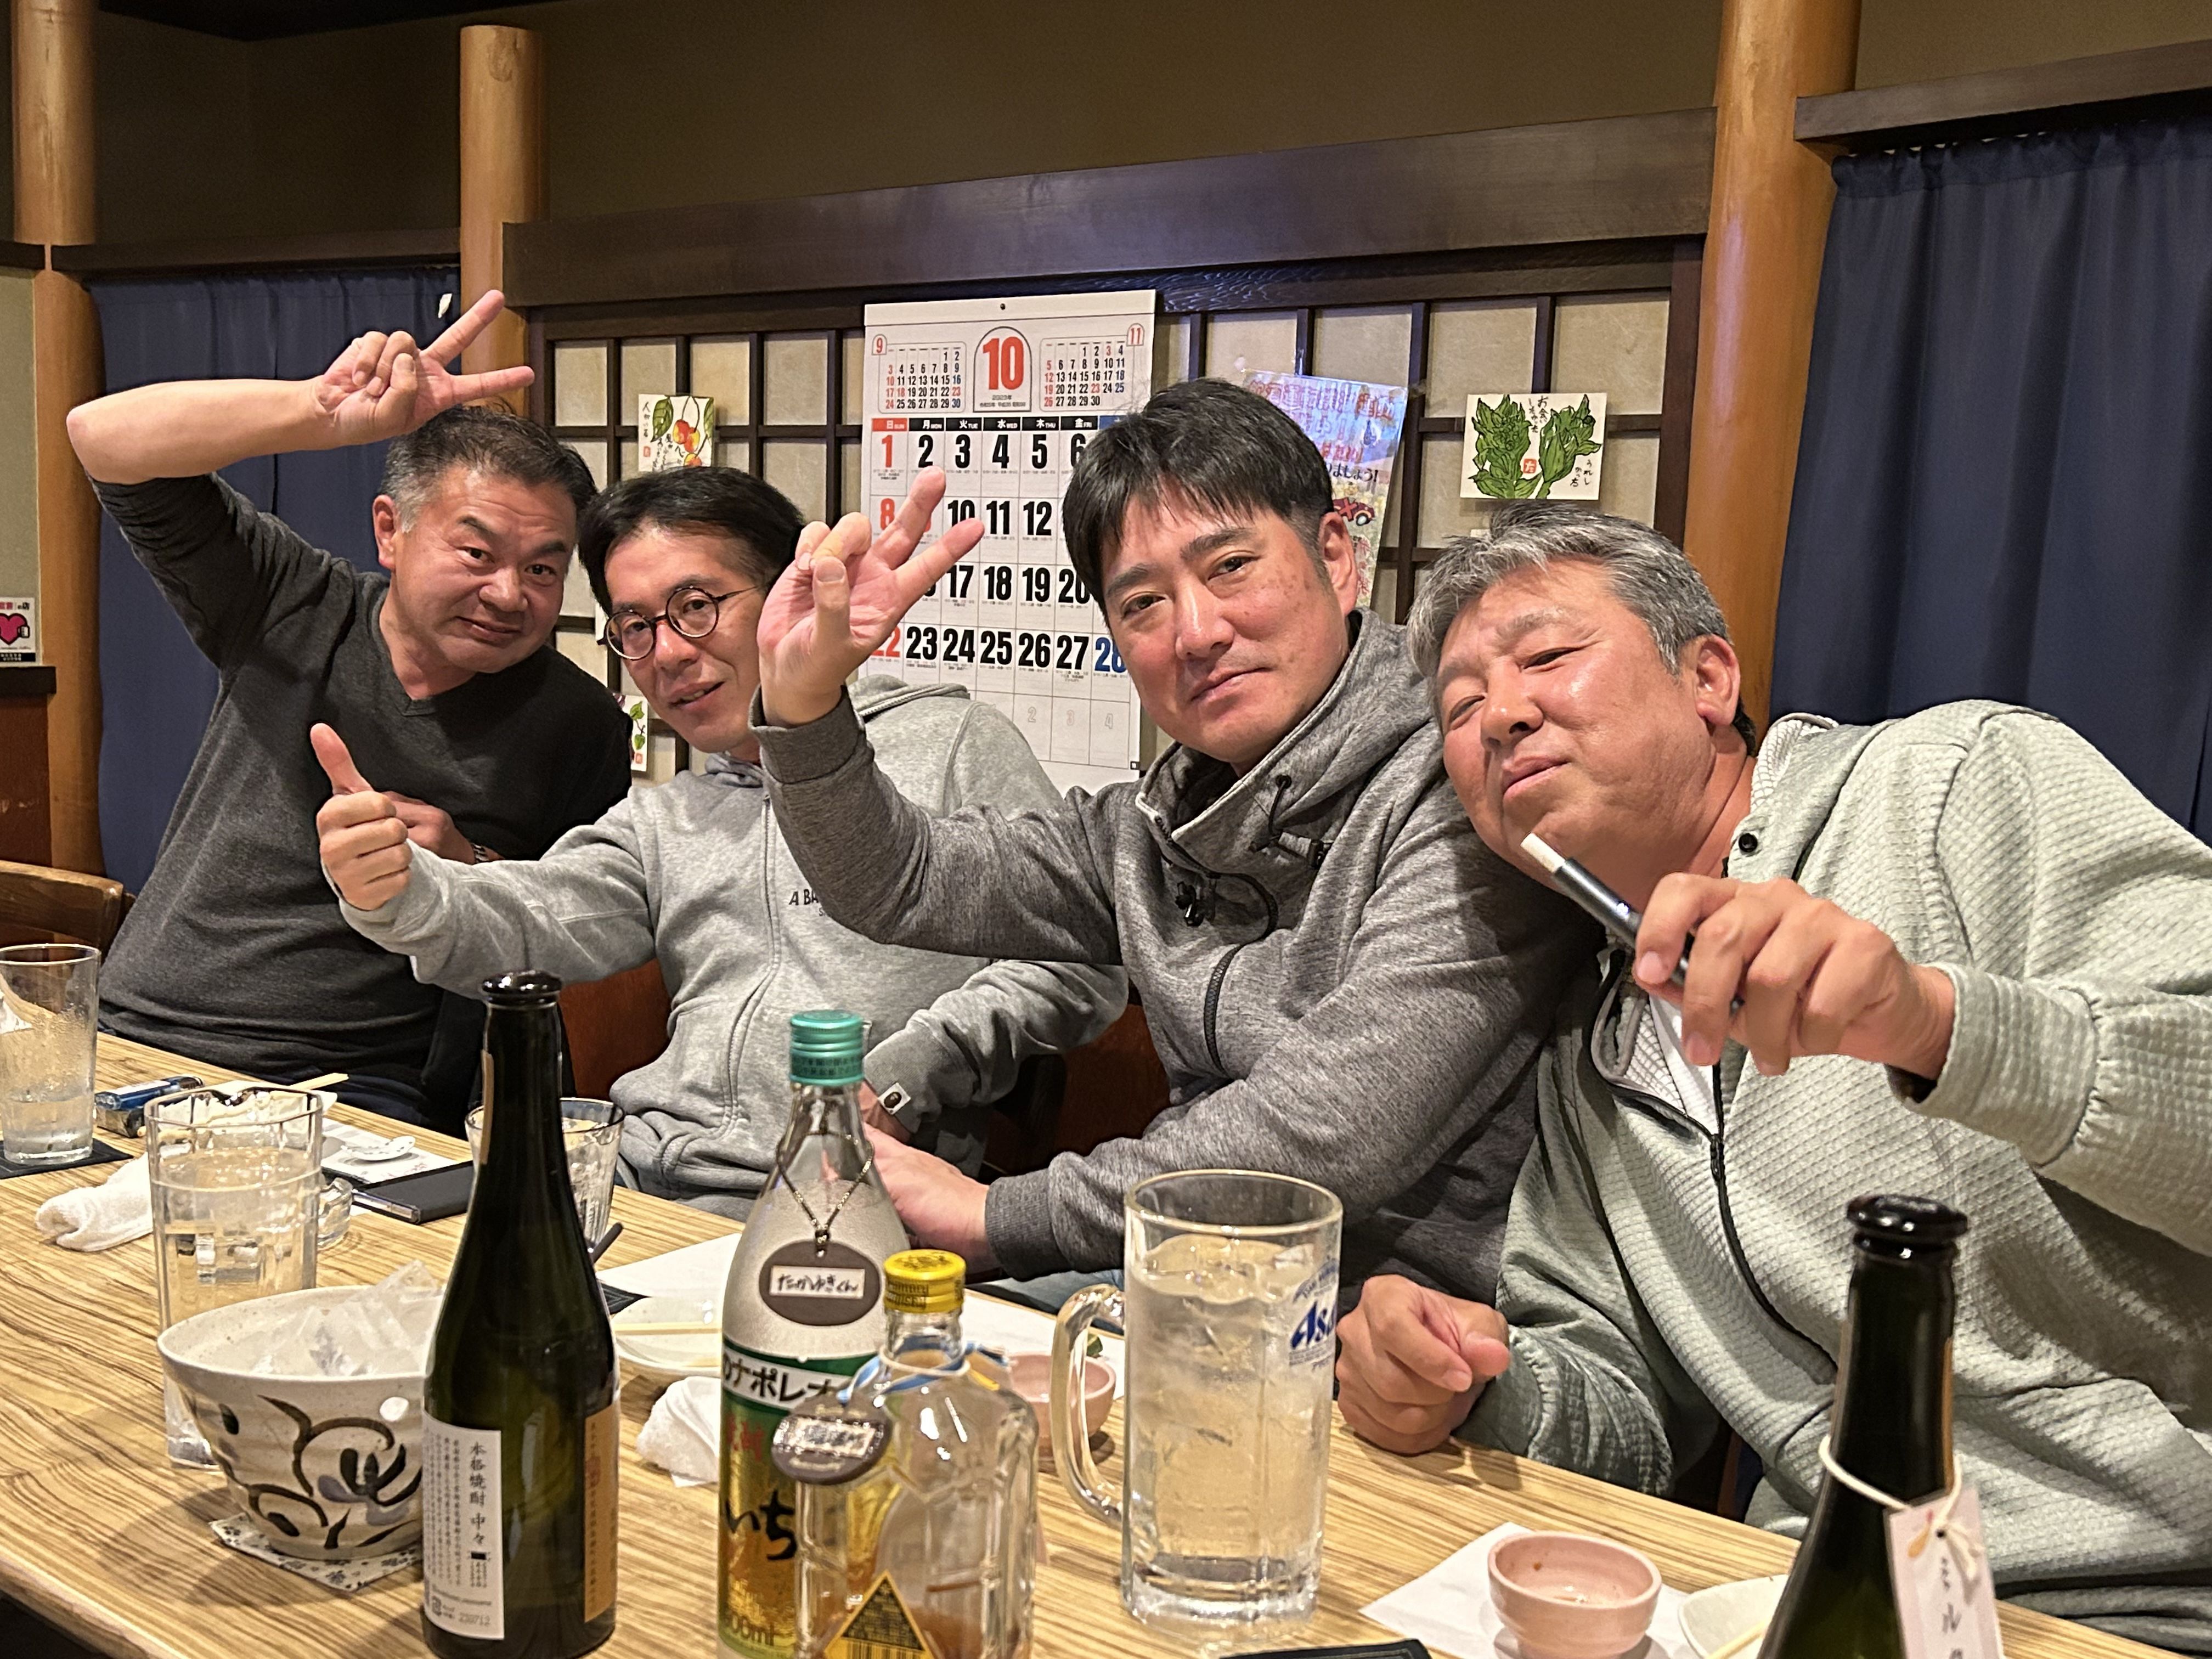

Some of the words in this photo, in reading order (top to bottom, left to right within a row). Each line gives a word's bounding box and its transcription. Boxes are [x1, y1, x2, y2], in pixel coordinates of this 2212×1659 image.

[1131, 328, 1141, 345] 11
[876, 337, 883, 353] 9
[1083, 347, 1086, 357] 1
[1094, 346, 1099, 356] 2
[1107, 346, 1111, 356] 3
[1118, 345, 1123, 355] 4
[944, 352, 947, 361] 1
[955, 351, 960, 361] 2
[888, 365, 893, 374] 3
[900, 364, 904, 374] 4
[910, 364, 914, 374] 5
[921, 363, 926, 374] 6
[933, 363, 936, 373] 7
[944, 363, 947, 373] 8
[955, 363, 959, 373] 9
[983, 336, 1024, 390] 10
[1047, 360, 1051, 370] 5
[1059, 360, 1063, 370] 6
[1071, 359, 1075, 369] 7
[1082, 359, 1087, 369] 8
[1094, 358, 1099, 369] 9
[1104, 358, 1113, 368] 10
[1116, 358, 1124, 368] 11
[887, 376, 894, 386] 10
[898, 376, 905, 386] 11
[909, 376, 916, 385] 12
[919, 375, 927, 385] 13
[930, 375, 938, 385] 14
[941, 375, 950, 385] 15
[953, 375, 961, 384] 16
[1045, 373, 1053, 382] 12
[1057, 372, 1065, 382] 13
[1069, 371, 1076, 382] 14
[1080, 371, 1088, 381] 15
[1092, 371, 1101, 381] 16
[1104, 371, 1113, 381] 17
[1116, 370, 1125, 380] 18
[887, 388, 894, 397] 17
[898, 388, 905, 397] 18
[908, 387, 916, 397] 19
[918, 387, 927, 397] 20
[930, 387, 938, 397] 21
[941, 387, 949, 396] 22
[952, 386, 961, 396] 23
[1045, 385, 1053, 394] 19
[1056, 384, 1065, 394] 20
[1068, 384, 1076, 394] 21
[1080, 383, 1088, 394] 22
[1091, 383, 1100, 393] 23
[1103, 383, 1112, 393] 24
[1115, 382, 1124, 393] 25
[886, 399, 894, 409] 24
[897, 399, 905, 409] 25
[907, 399, 916, 409] 26
[918, 399, 927, 408] 27
[930, 399, 938, 408] 28
[941, 399, 949, 408] 29
[952, 398, 961, 408] 30
[1045, 397, 1053, 407] 26
[1056, 397, 1064, 407] 27
[1068, 397, 1076, 407] 28
[1080, 396, 1088, 406] 29
[1091, 396, 1100, 405] 30
[887, 420, 894, 429] 日
[922, 420, 930, 429] 月
[960, 419, 968, 429] 火
[997, 419, 1006, 428] 水
[1036, 419, 1045, 428] 木
[1075, 418, 1084, 428] 金
[882, 435, 893, 468] 1
[918, 435, 933, 468] 2
[955, 434, 970, 469] 3
[992, 435, 1009, 469] 4
[1032, 434, 1047, 469] 5
[880, 498, 895, 530] 8
[986, 500, 1010, 535] 11
[1023, 501, 1052, 535] 12
[947, 565, 974, 598] 17
[984, 566, 1012, 600] 18
[1022, 567, 1050, 602] 19
[1058, 568, 1090, 604] 20
[871, 626, 900, 657] 2
[906, 626, 937, 660] 23
[943, 628, 975, 663] 24
[980, 630, 1012, 665] 25
[1018, 633, 1051, 668] 26
[1056, 635, 1089, 670] 27
[1094, 637, 1127, 673] 28
[1028, 707, 1036, 723] 2
[1104, 713, 1113, 729] 4
[789, 891, 799, 906] A
[470, 1441, 487, 1506] 本格焼酎
[470, 1512, 486, 1545] 中々
